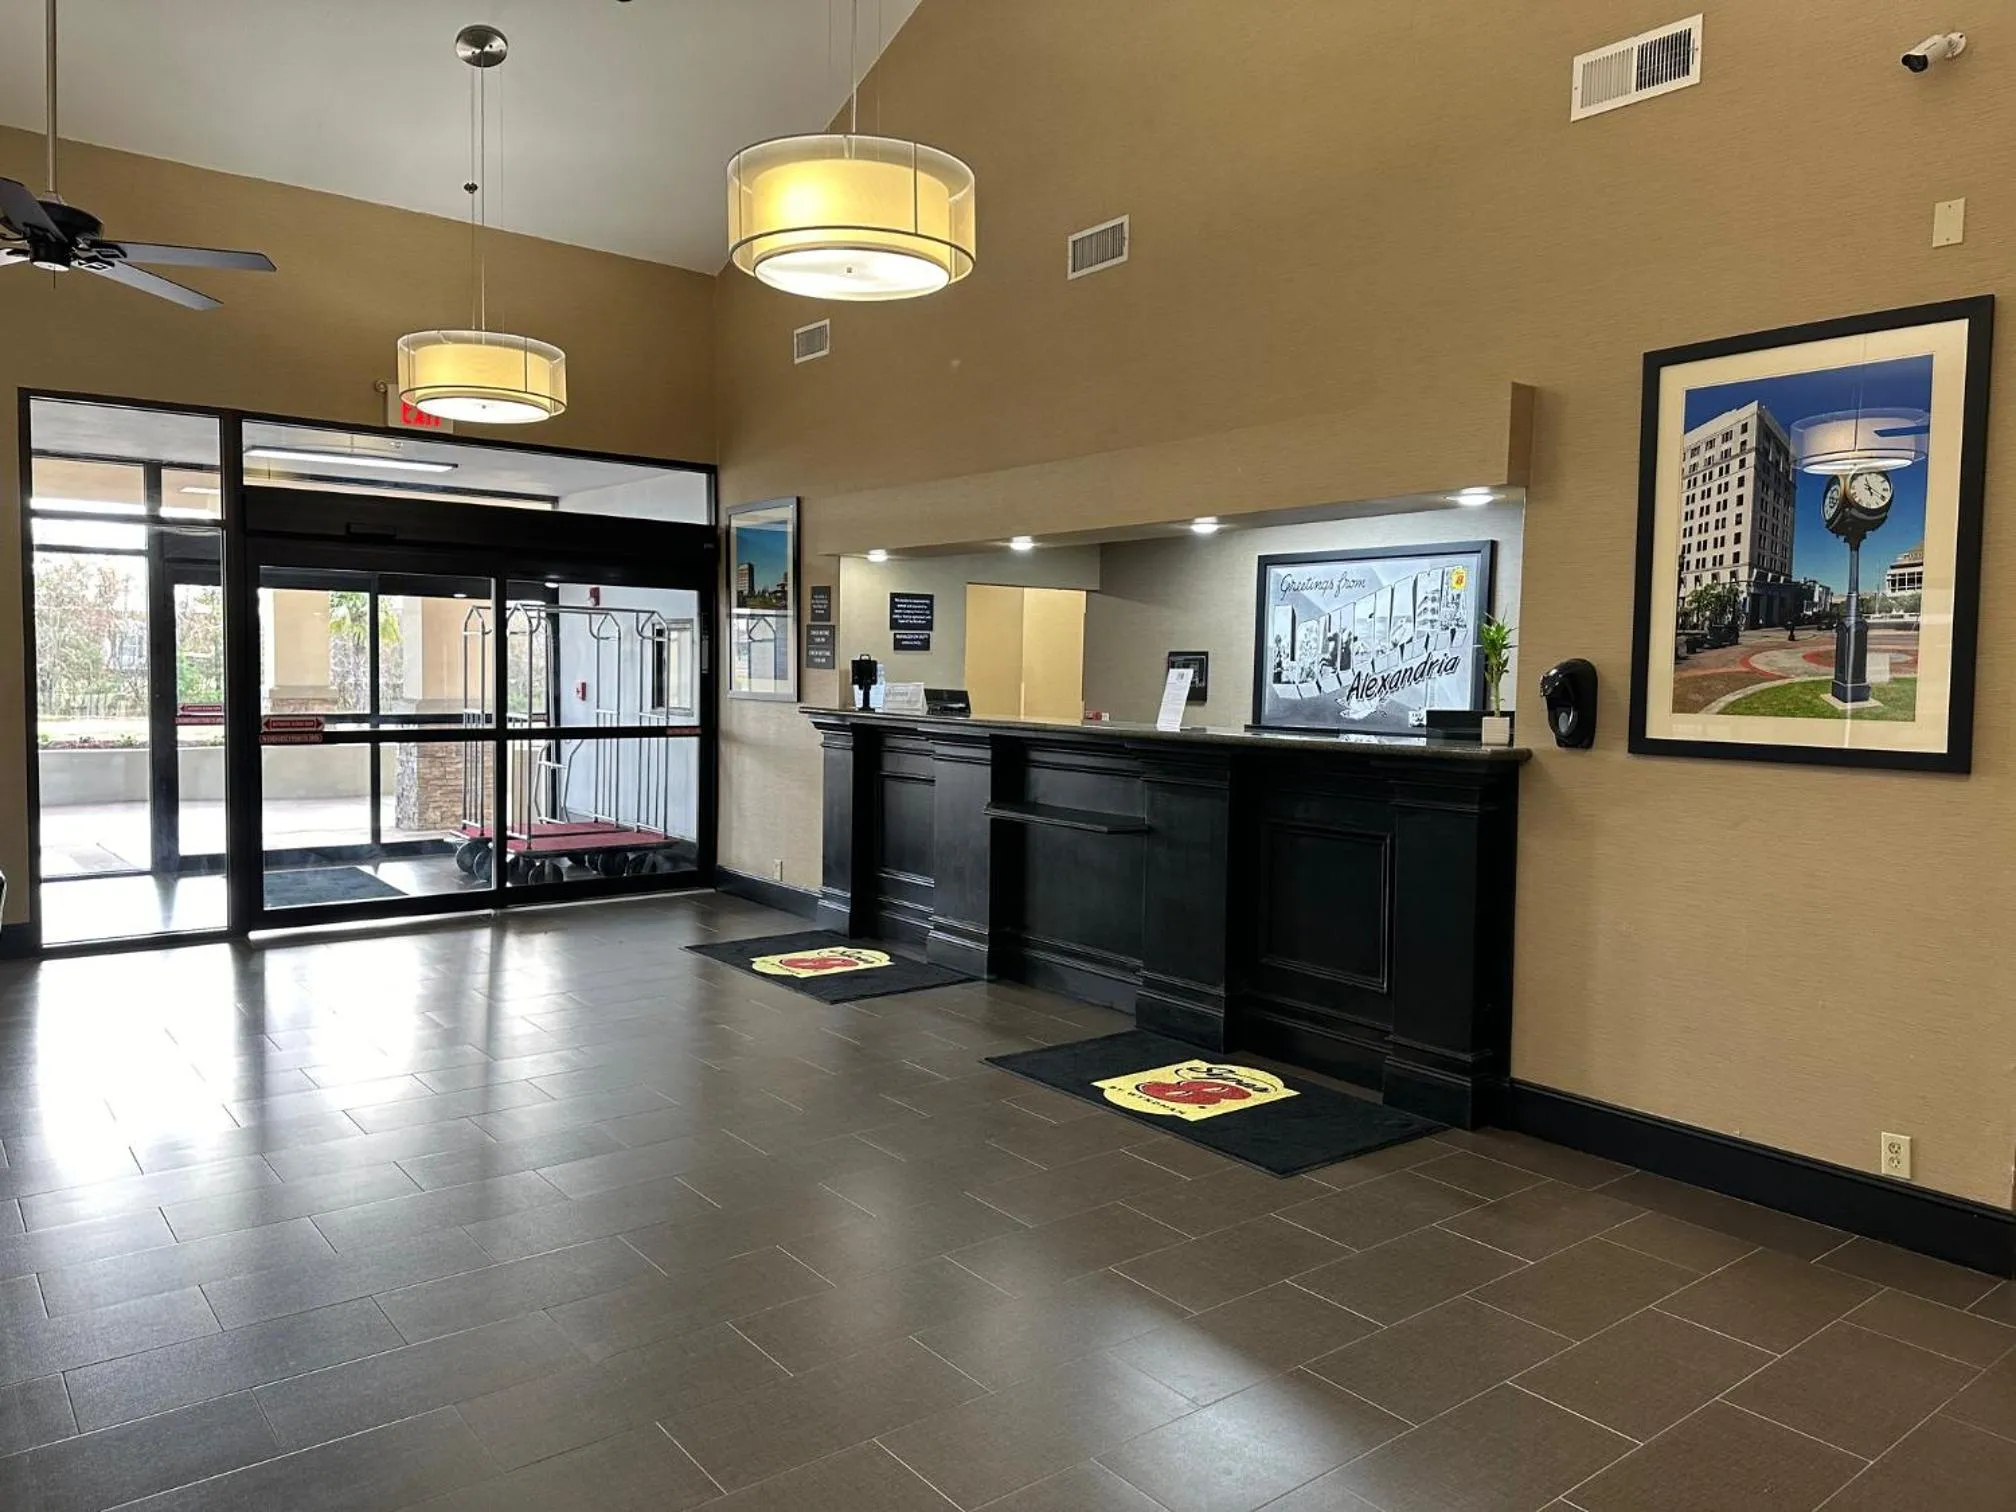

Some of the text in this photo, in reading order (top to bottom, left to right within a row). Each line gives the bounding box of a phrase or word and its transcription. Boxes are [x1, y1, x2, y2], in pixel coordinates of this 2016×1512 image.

[1280, 568, 1366, 601] Greetings from
[1346, 651, 1461, 702] Alexandria
